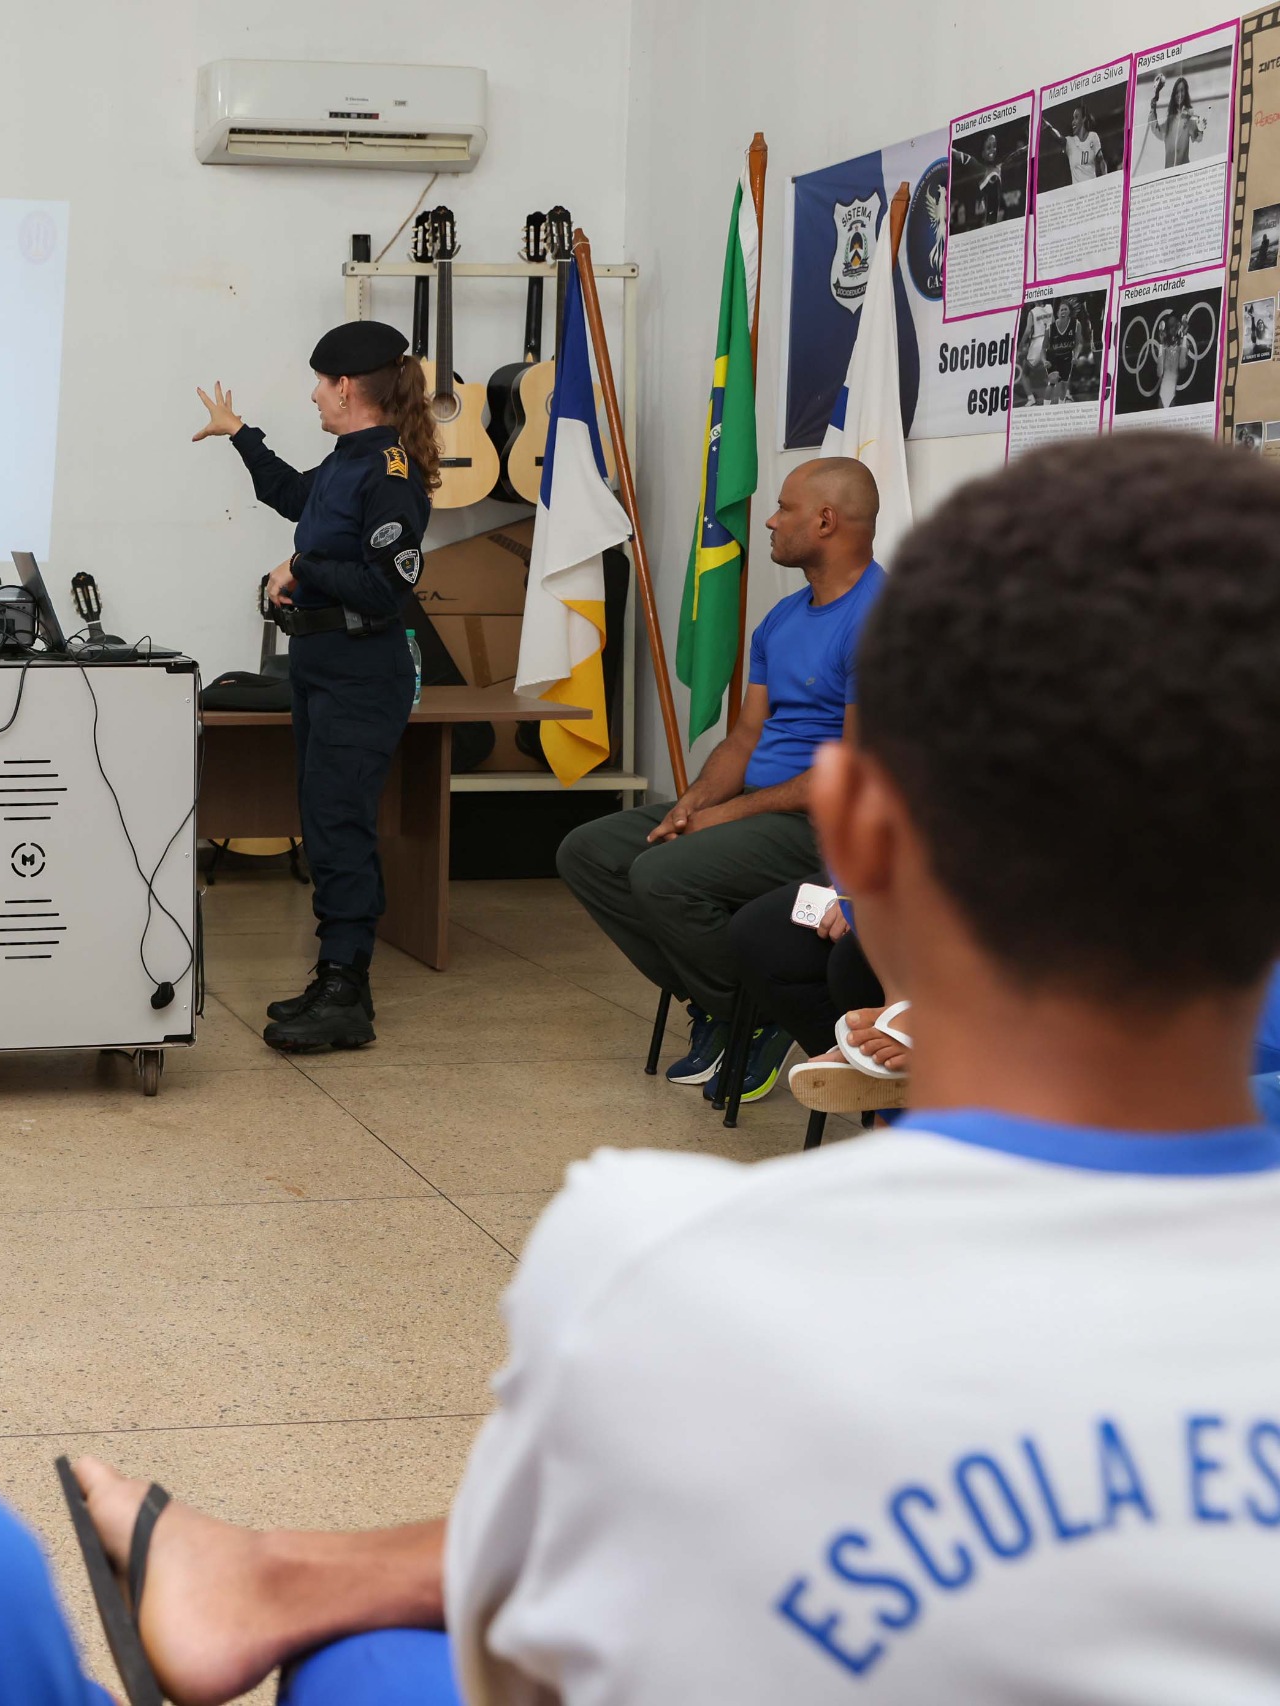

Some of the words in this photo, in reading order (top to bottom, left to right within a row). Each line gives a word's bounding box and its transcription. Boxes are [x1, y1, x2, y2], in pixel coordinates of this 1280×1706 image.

[1137, 51, 1164, 68] Rayssa
[1166, 44, 1182, 61] Leal
[1048, 85, 1069, 101] Marta
[1070, 77, 1089, 97] Vieira
[1091, 73, 1102, 85] da
[1103, 65, 1123, 81] Silva
[955, 116, 977, 133] Daiane
[978, 113, 992, 127] dos
[993, 104, 1017, 121] Santos
[842, 206, 872, 227] SISTEMA
[1124, 284, 1150, 301] Rebeca
[1152, 277, 1186, 296] Andrade
[775, 1416, 1157, 1677] ESCOLA
